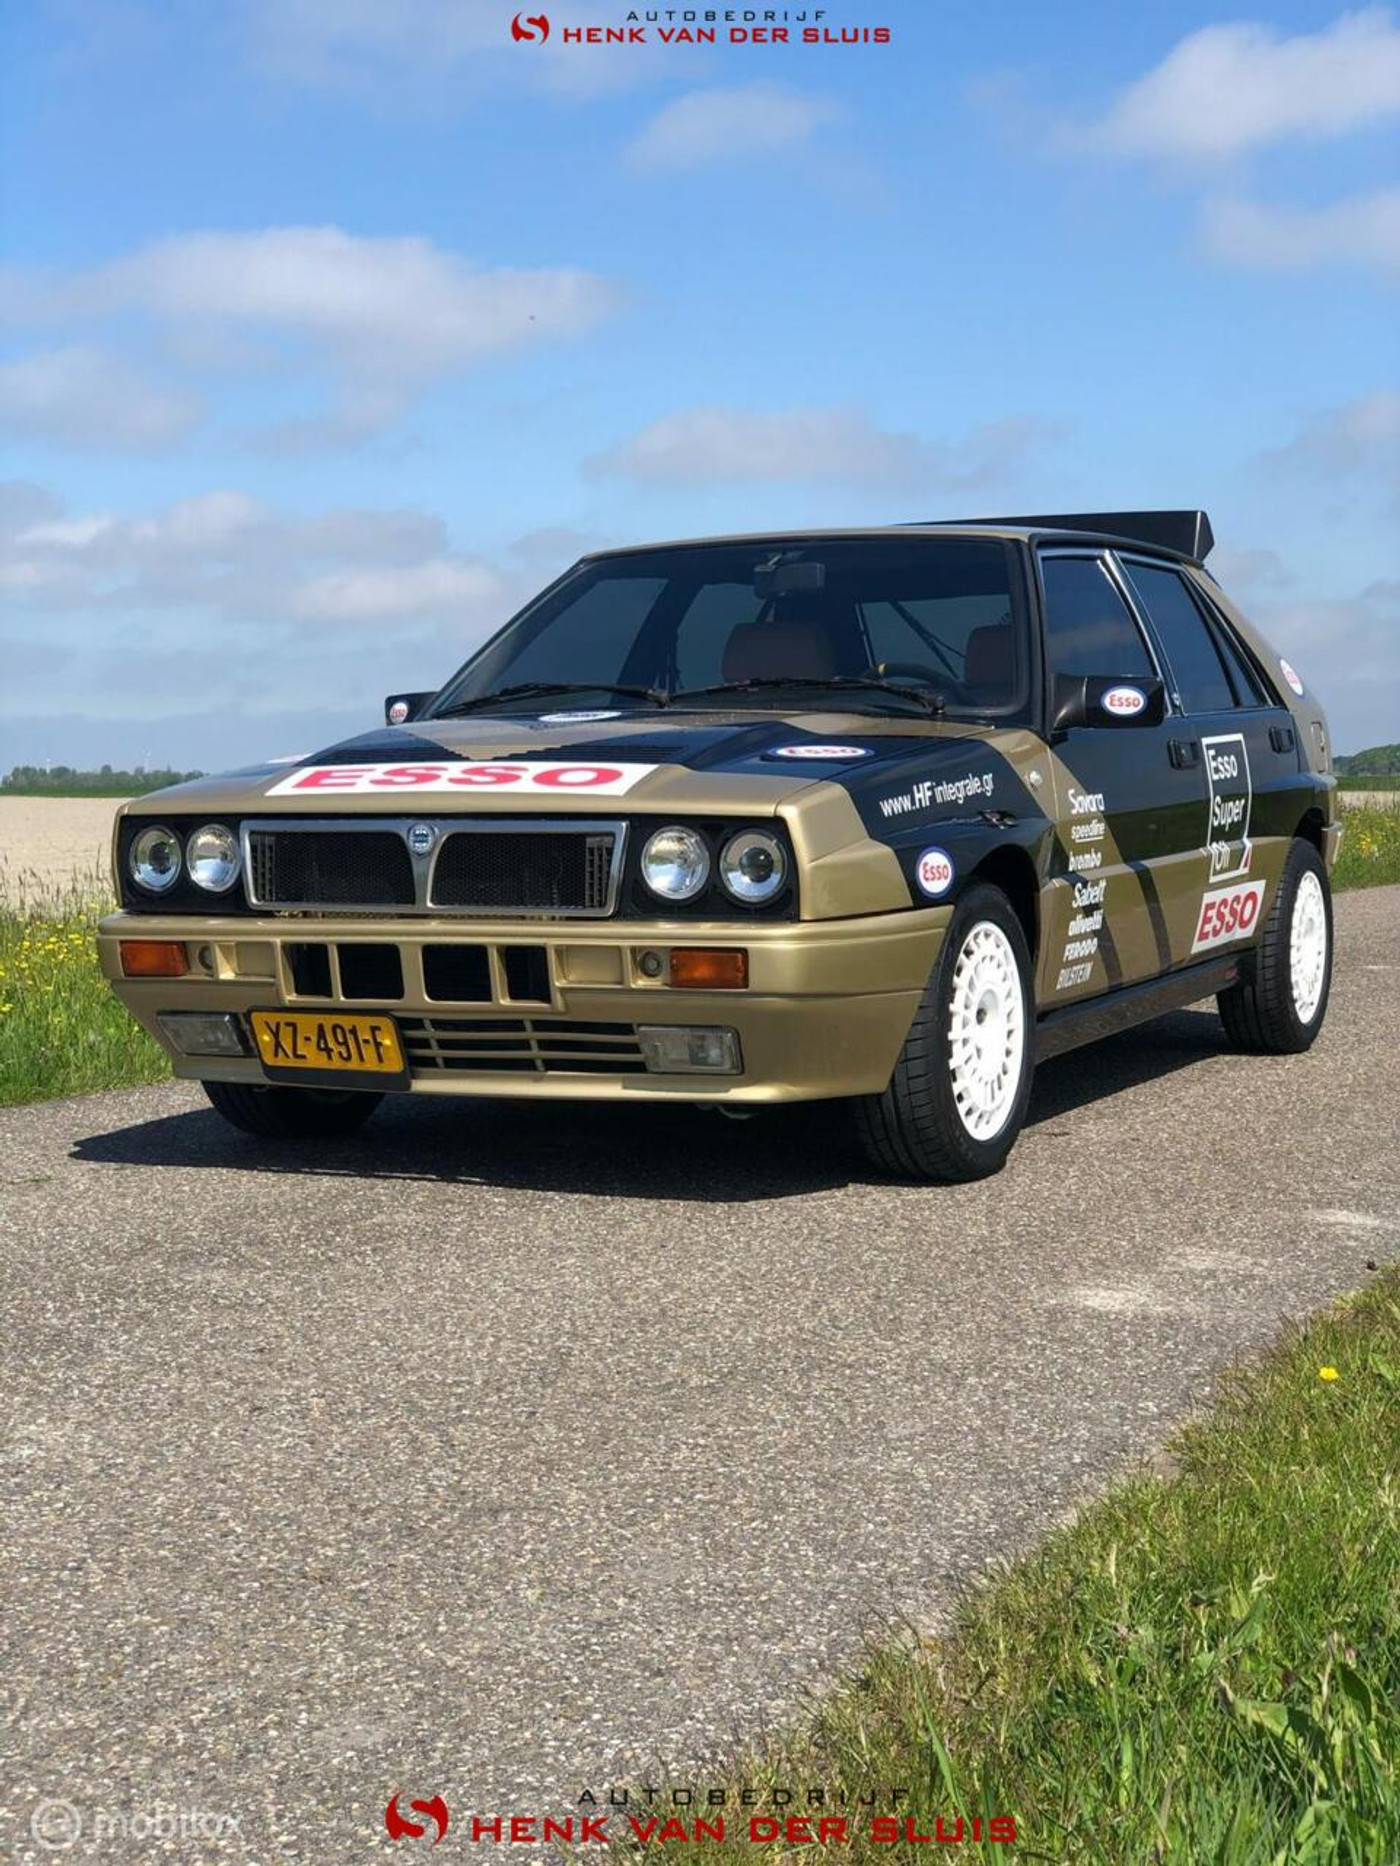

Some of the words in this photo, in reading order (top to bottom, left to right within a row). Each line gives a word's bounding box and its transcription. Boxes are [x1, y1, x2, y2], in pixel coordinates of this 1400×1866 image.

[1109, 694, 1140, 708] Esso
[292, 766, 624, 790] ESSO
[1209, 750, 1238, 780] Esso
[1212, 796, 1246, 832] Super
[922, 862, 950, 883] Esso
[1197, 890, 1259, 941] ESSO
[264, 1020, 384, 1063] XZ-491-F
